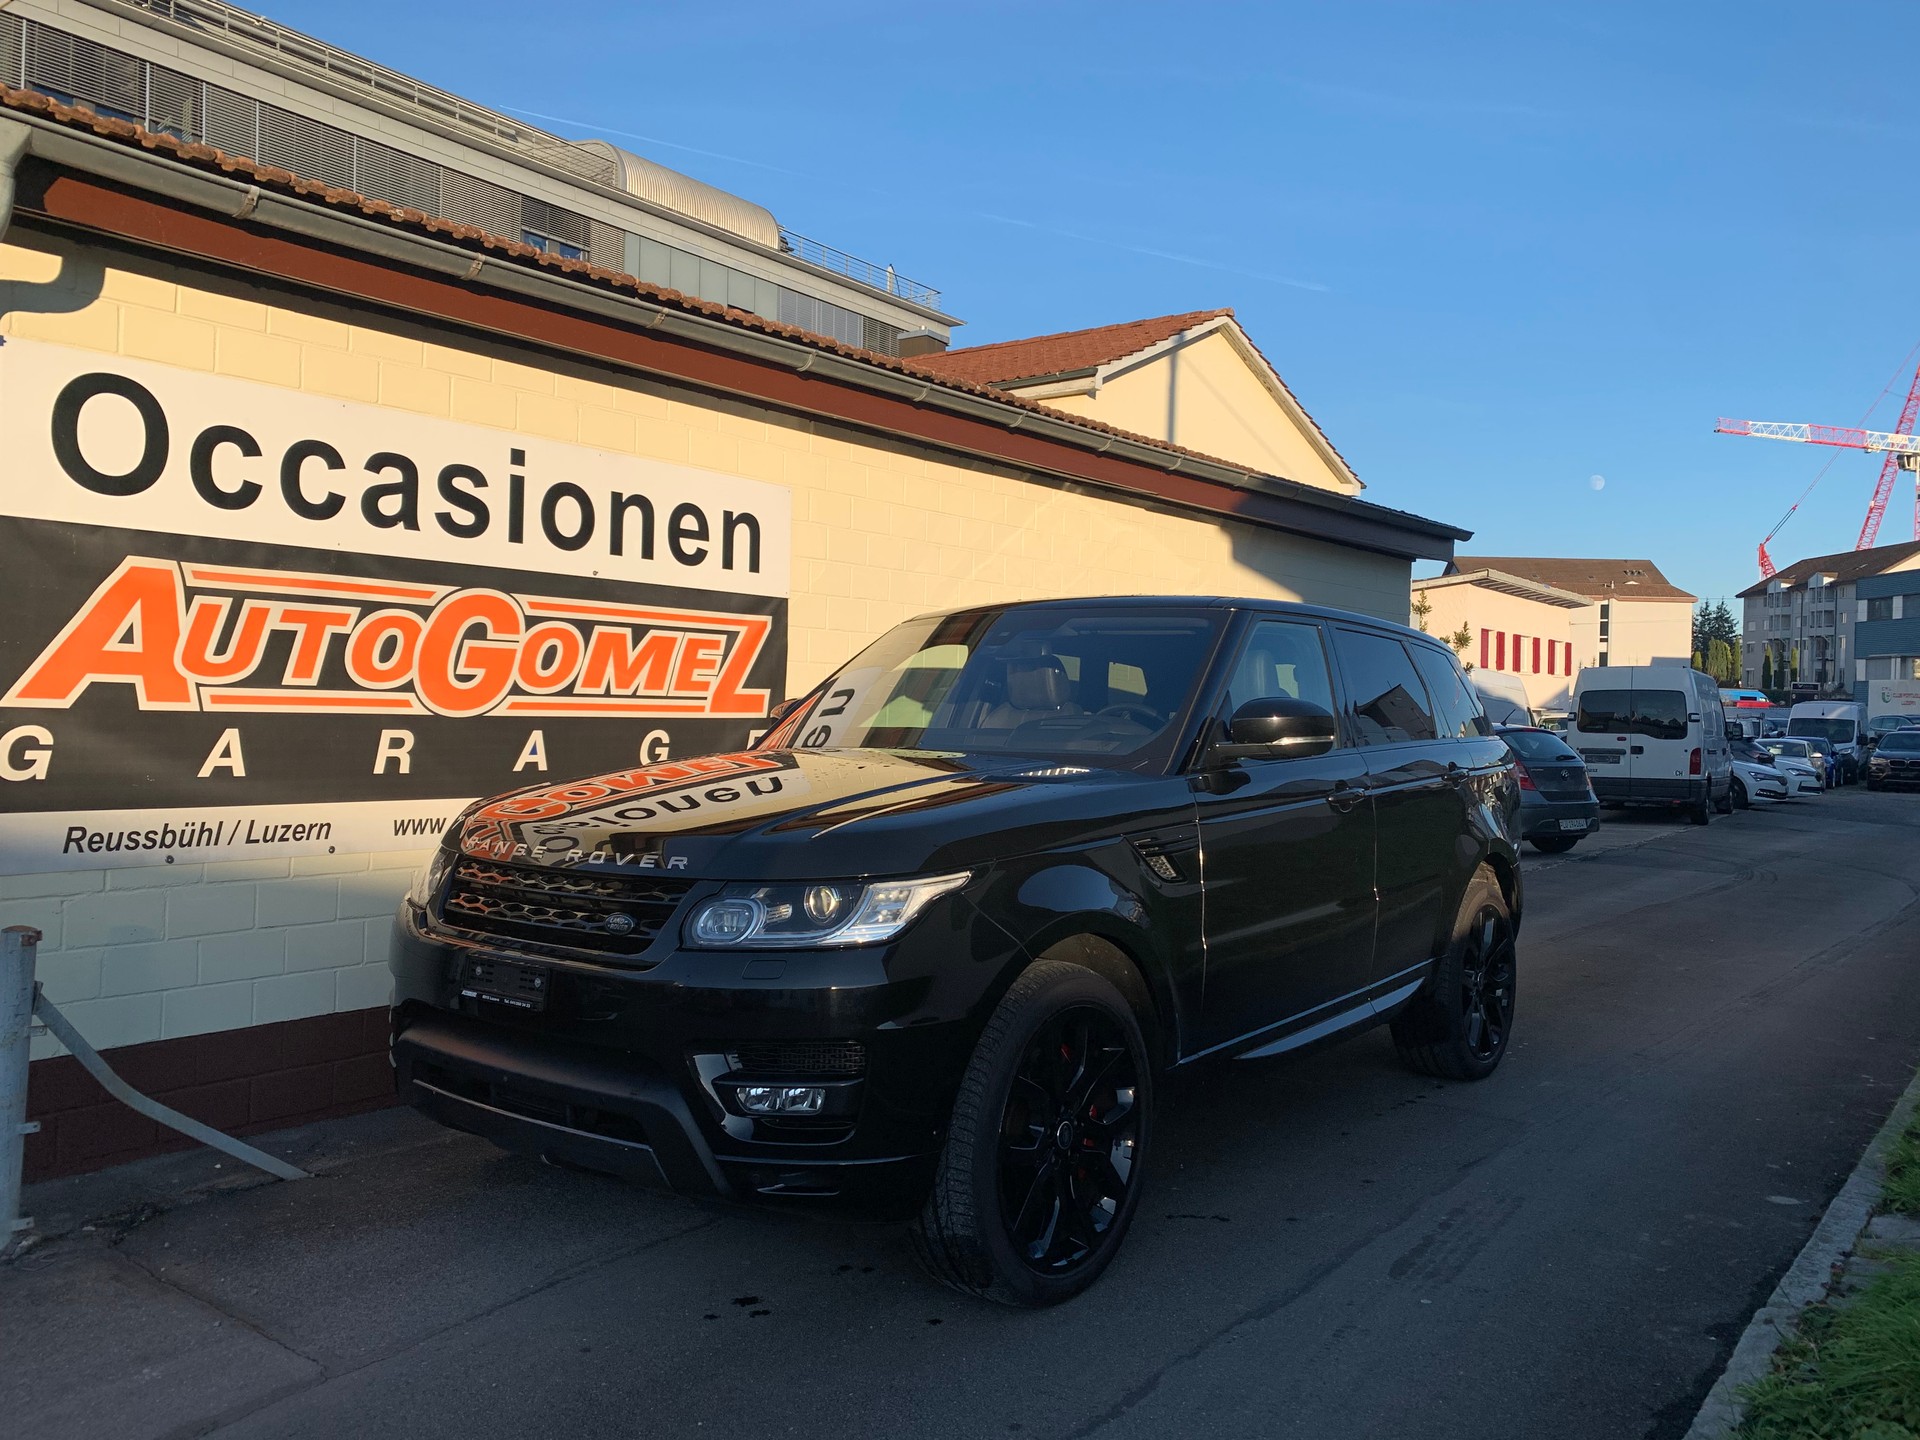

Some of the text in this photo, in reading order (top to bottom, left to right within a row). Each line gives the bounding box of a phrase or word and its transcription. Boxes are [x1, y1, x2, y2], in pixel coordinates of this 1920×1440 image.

[52, 373, 760, 573] Occasionen
[63, 820, 224, 855] Reussbühl
[245, 820, 332, 845] Luzern
[466, 837, 688, 870] RANGE ROVER
